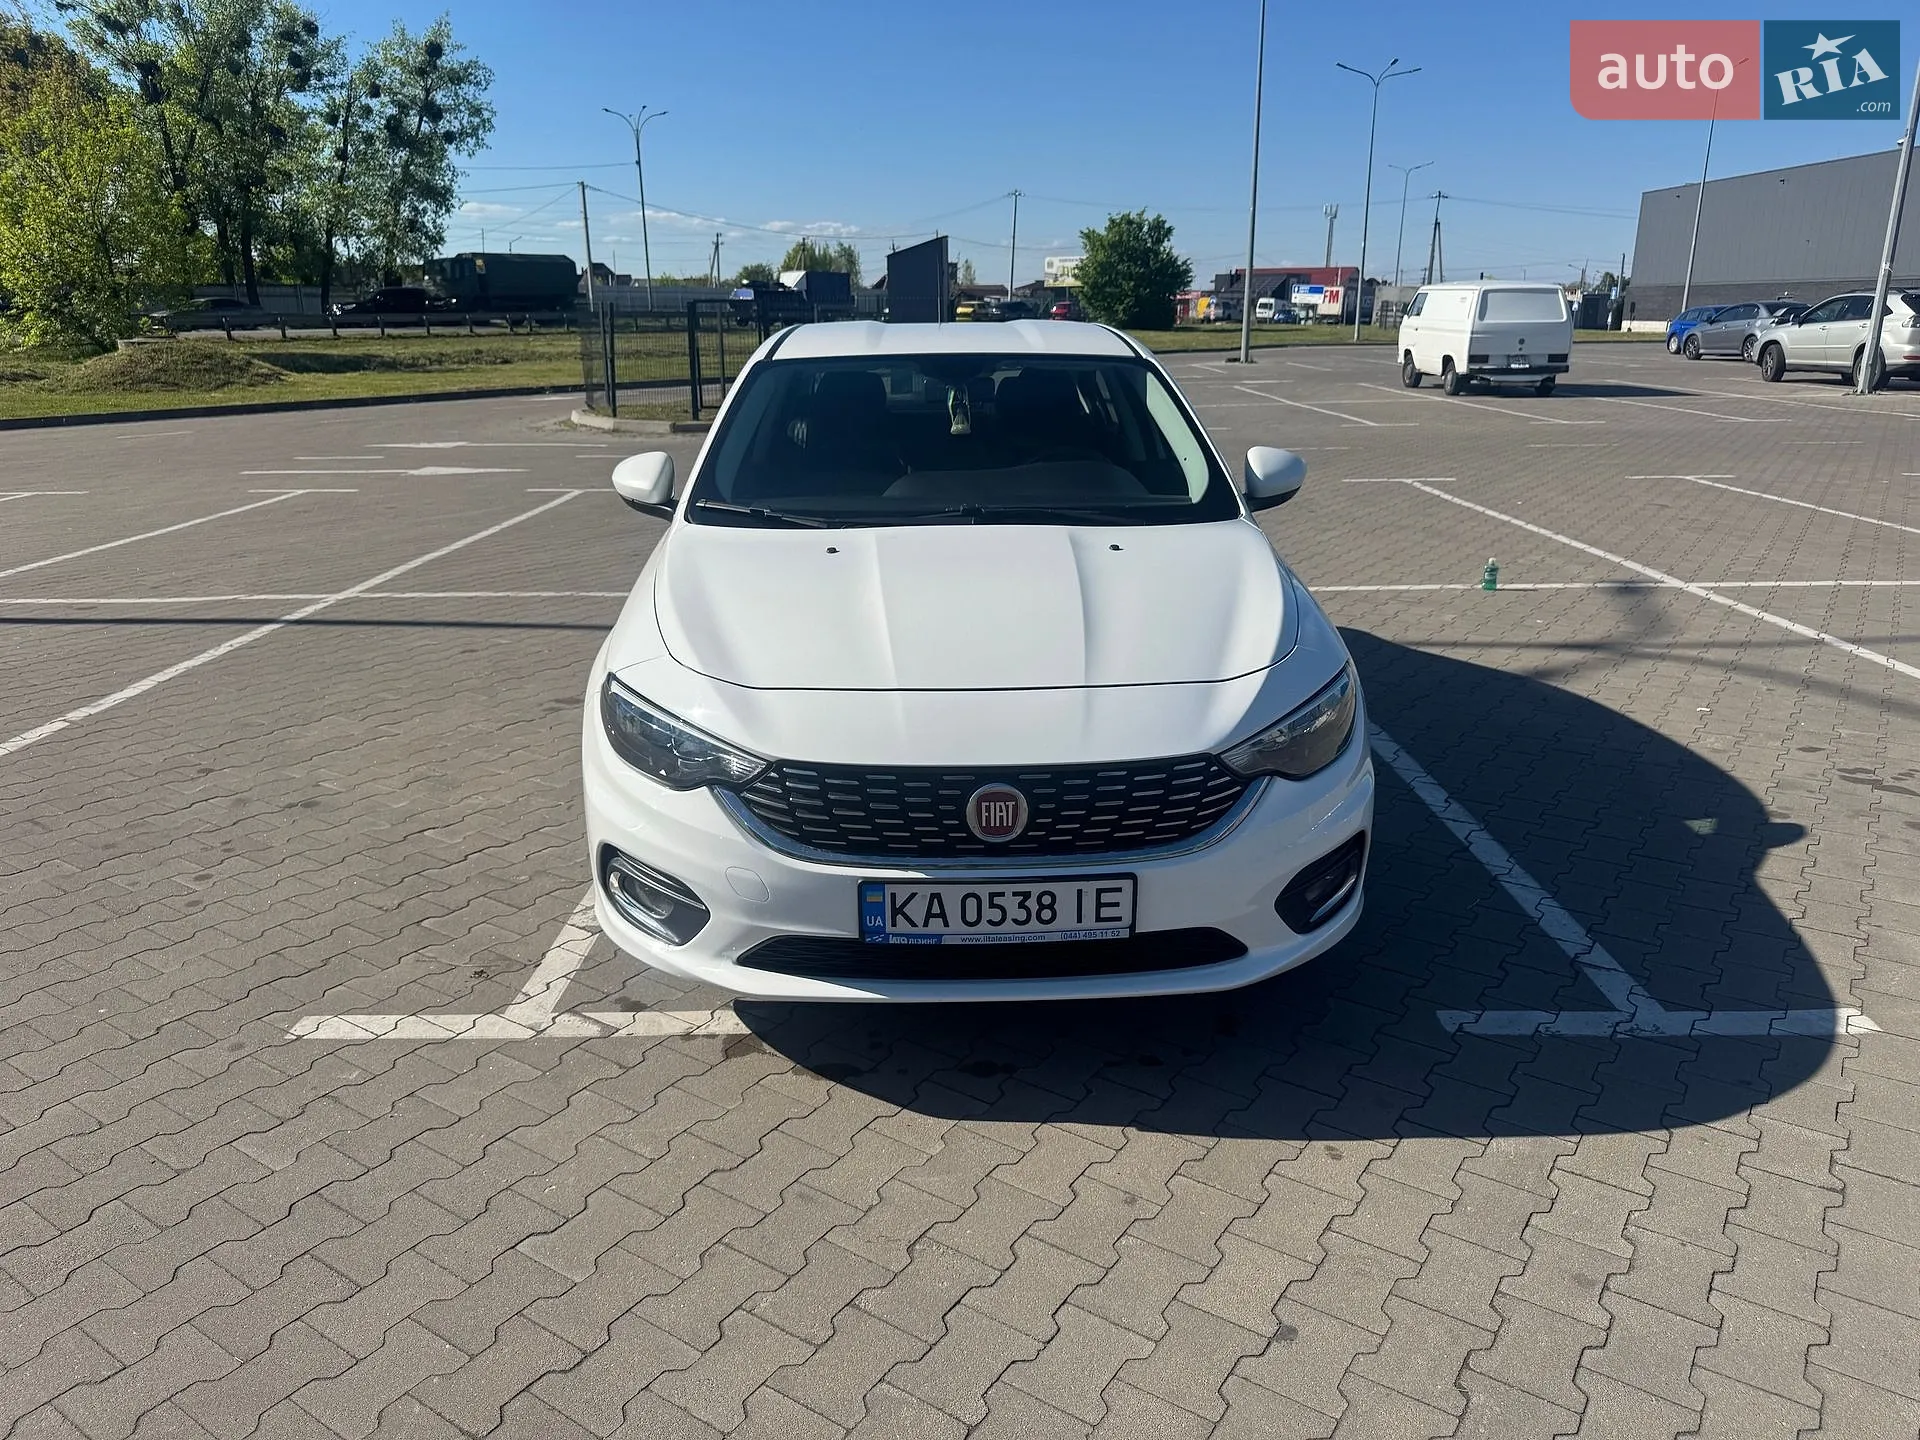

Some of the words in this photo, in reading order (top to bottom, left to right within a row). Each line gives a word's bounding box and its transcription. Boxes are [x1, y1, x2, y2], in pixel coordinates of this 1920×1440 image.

[981, 801, 1016, 827] FIAT
[890, 891, 950, 928] KA
[960, 890, 1057, 928] 0538
[1076, 887, 1123, 923] IE
[866, 915, 884, 927] UA
[1060, 932, 1081, 940] (044)
[1082, 931, 1098, 939] 495
